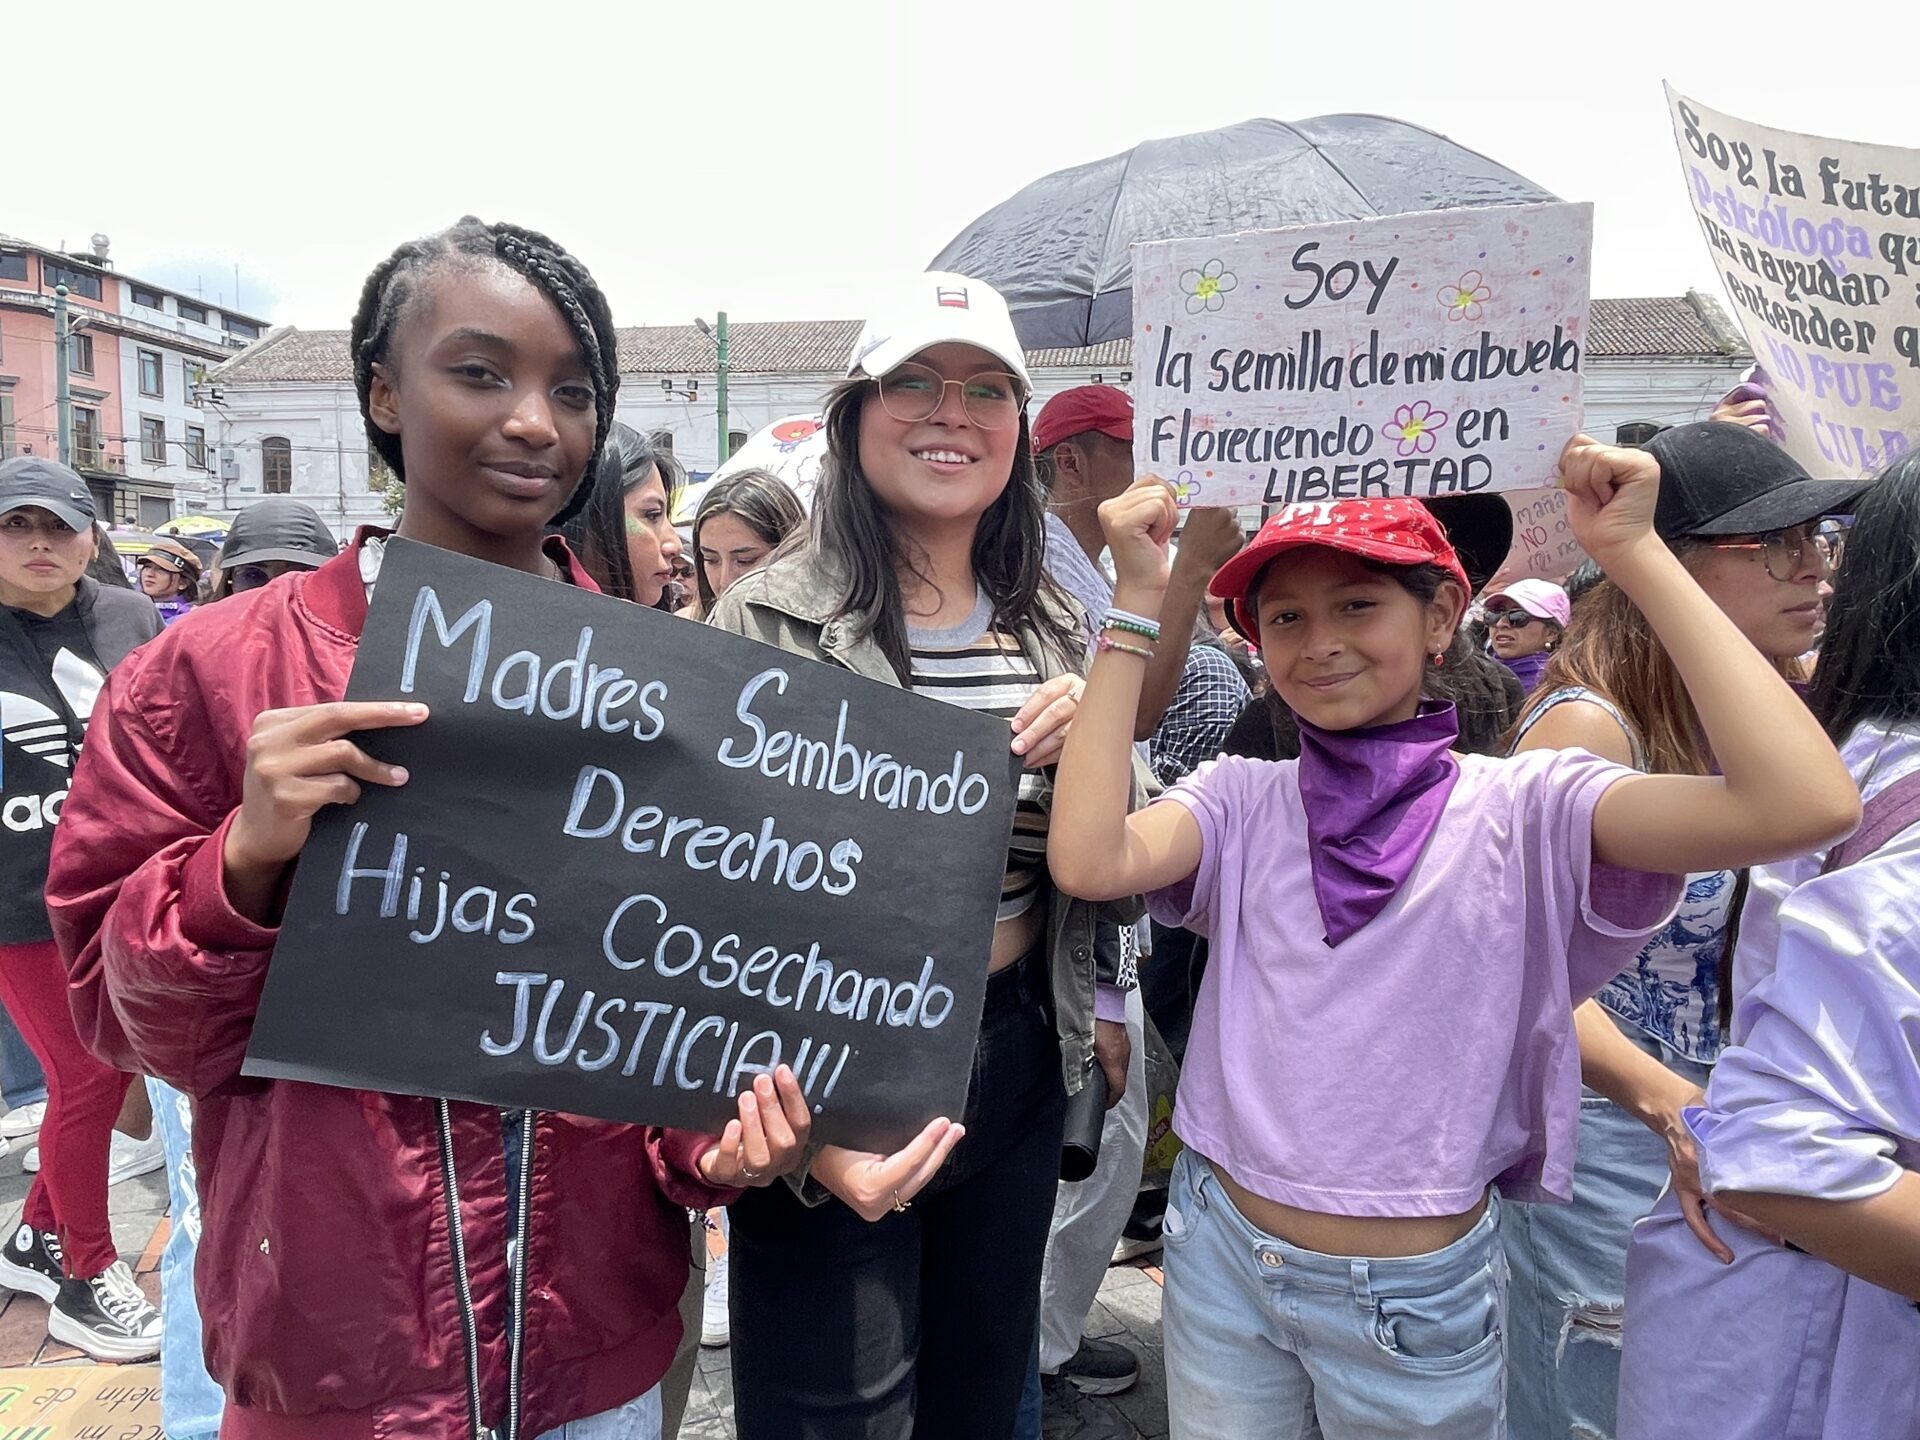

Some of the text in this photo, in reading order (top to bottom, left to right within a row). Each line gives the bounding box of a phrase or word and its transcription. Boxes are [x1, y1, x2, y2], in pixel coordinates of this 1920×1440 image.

[1678, 100, 1759, 190] Soy
[1762, 148, 1806, 200] la
[1690, 165, 1873, 278] Psicóloga
[1701, 213, 1740, 265] va
[1737, 238, 1762, 278] a
[1757, 248, 1890, 306] ayudar
[1285, 242, 1400, 315] Soy
[1726, 271, 1876, 355] entender
[1155, 325, 1580, 393] la semilla de mi abuela
[1761, 330, 1902, 412] NO FUE
[1152, 407, 1510, 465] Floreciendo en
[1262, 454, 1493, 504] LIBERTAD
[1520, 526, 1547, 552] NO
[400, 586, 990, 815] Madres Sembrando
[563, 764, 863, 897] Derechos
[336, 822, 954, 1029] Hijas Cosechando
[32, 1387, 77, 1413] de
